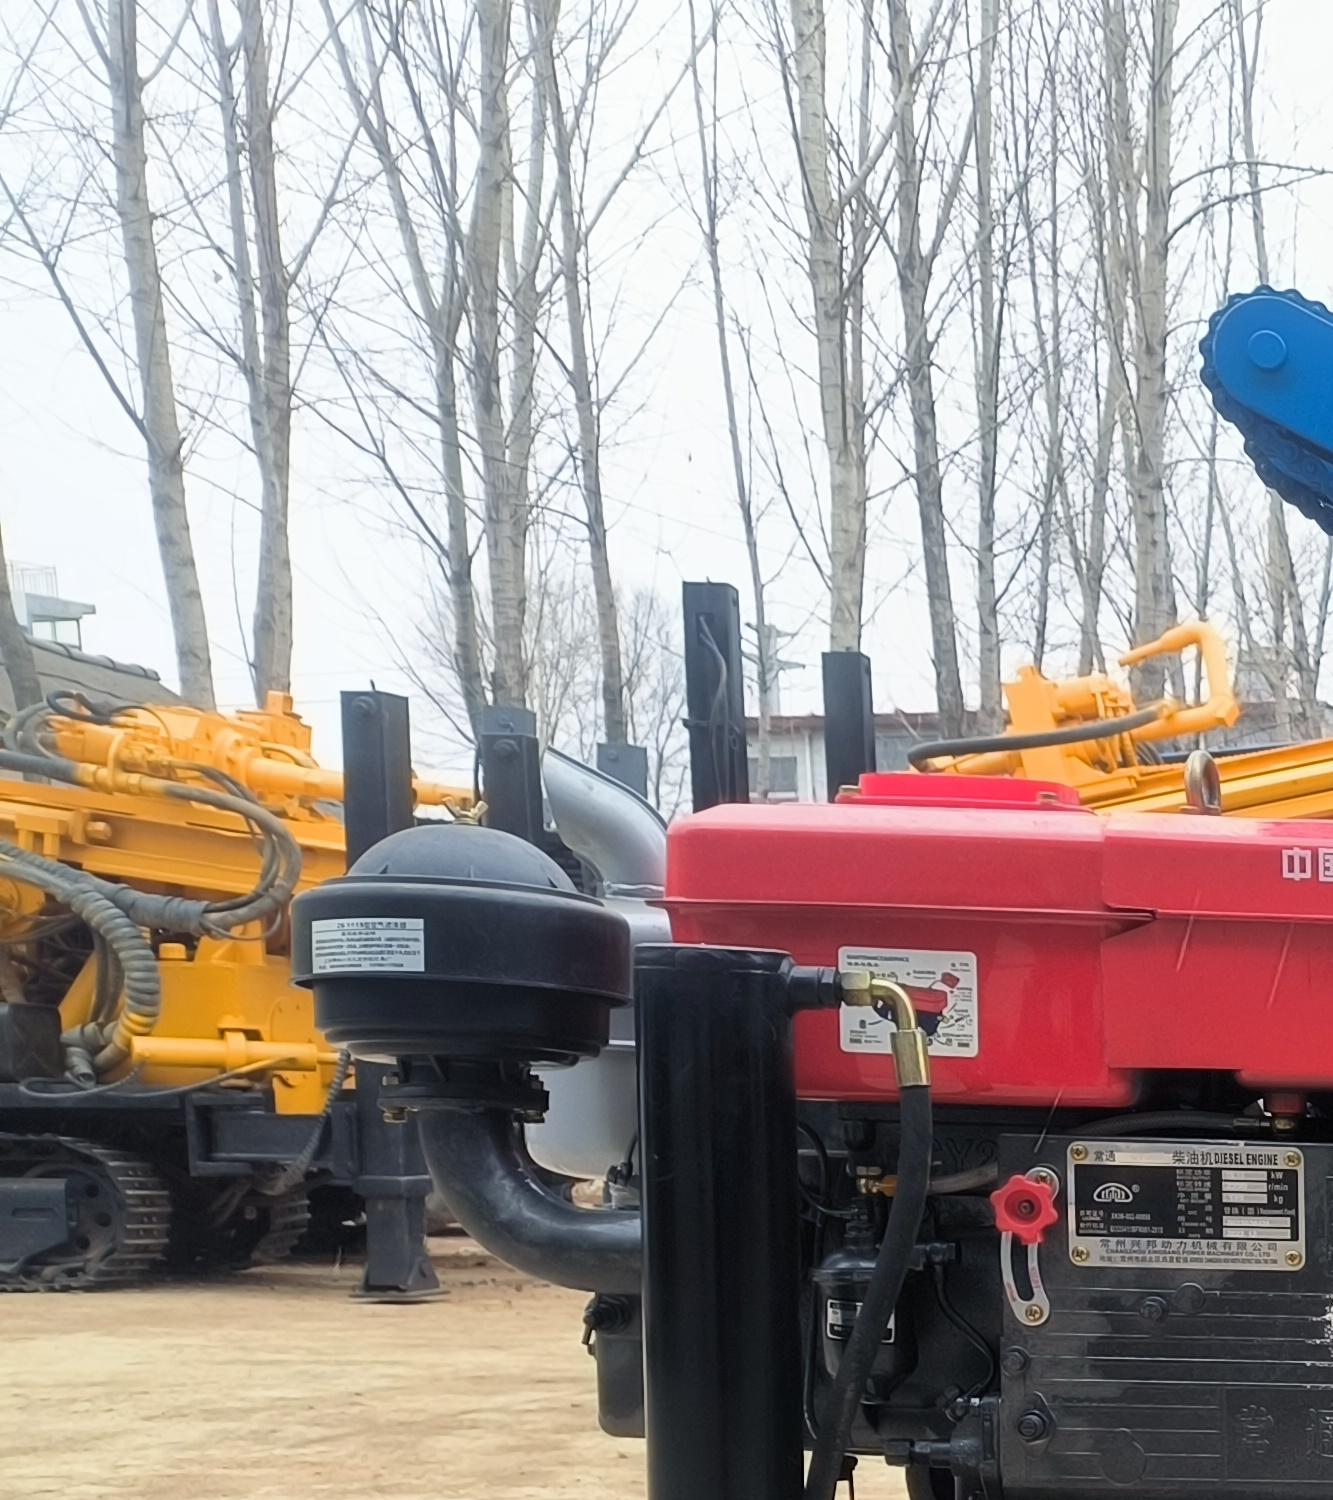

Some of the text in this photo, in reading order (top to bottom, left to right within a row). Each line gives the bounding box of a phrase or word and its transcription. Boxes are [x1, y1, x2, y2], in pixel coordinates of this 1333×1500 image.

[1172, 1150, 1213, 1165] 柴油机
[1214, 1152, 1244, 1165] DIESEL
[1246, 1153, 1278, 1166] ENGINE
